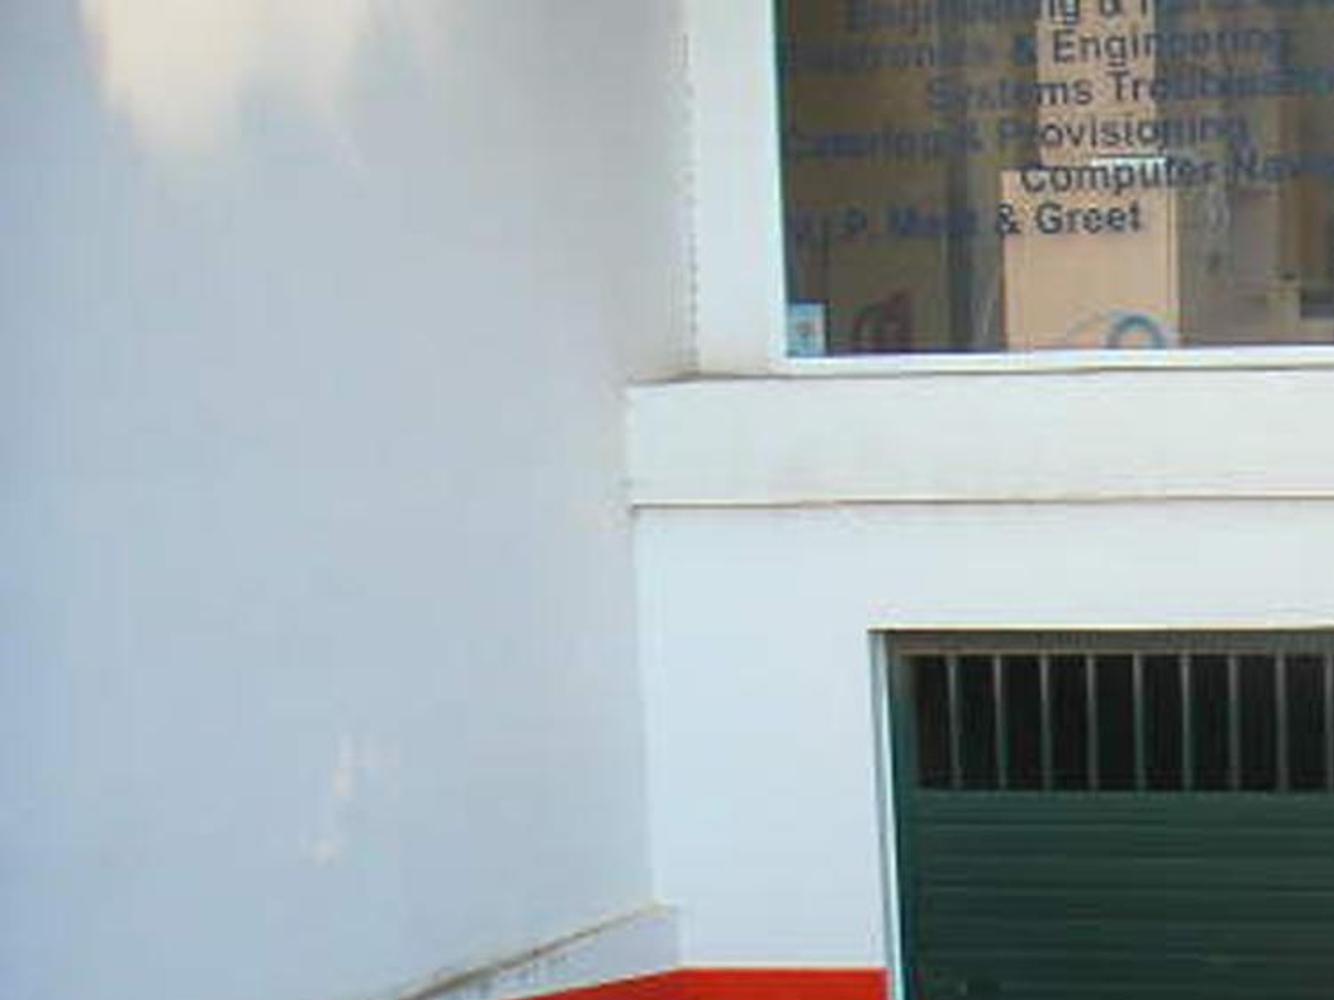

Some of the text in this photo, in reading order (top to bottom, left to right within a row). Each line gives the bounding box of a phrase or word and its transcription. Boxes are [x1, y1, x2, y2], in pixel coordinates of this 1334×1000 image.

[1053, 24, 1290, 66] Engineering
[928, 74, 1093, 118] Systems
[997, 108, 1254, 151] Provisioning
[1021, 156, 1225, 198] Computer
[996, 202, 1022, 236] &
[1036, 199, 1141, 236] Greet
